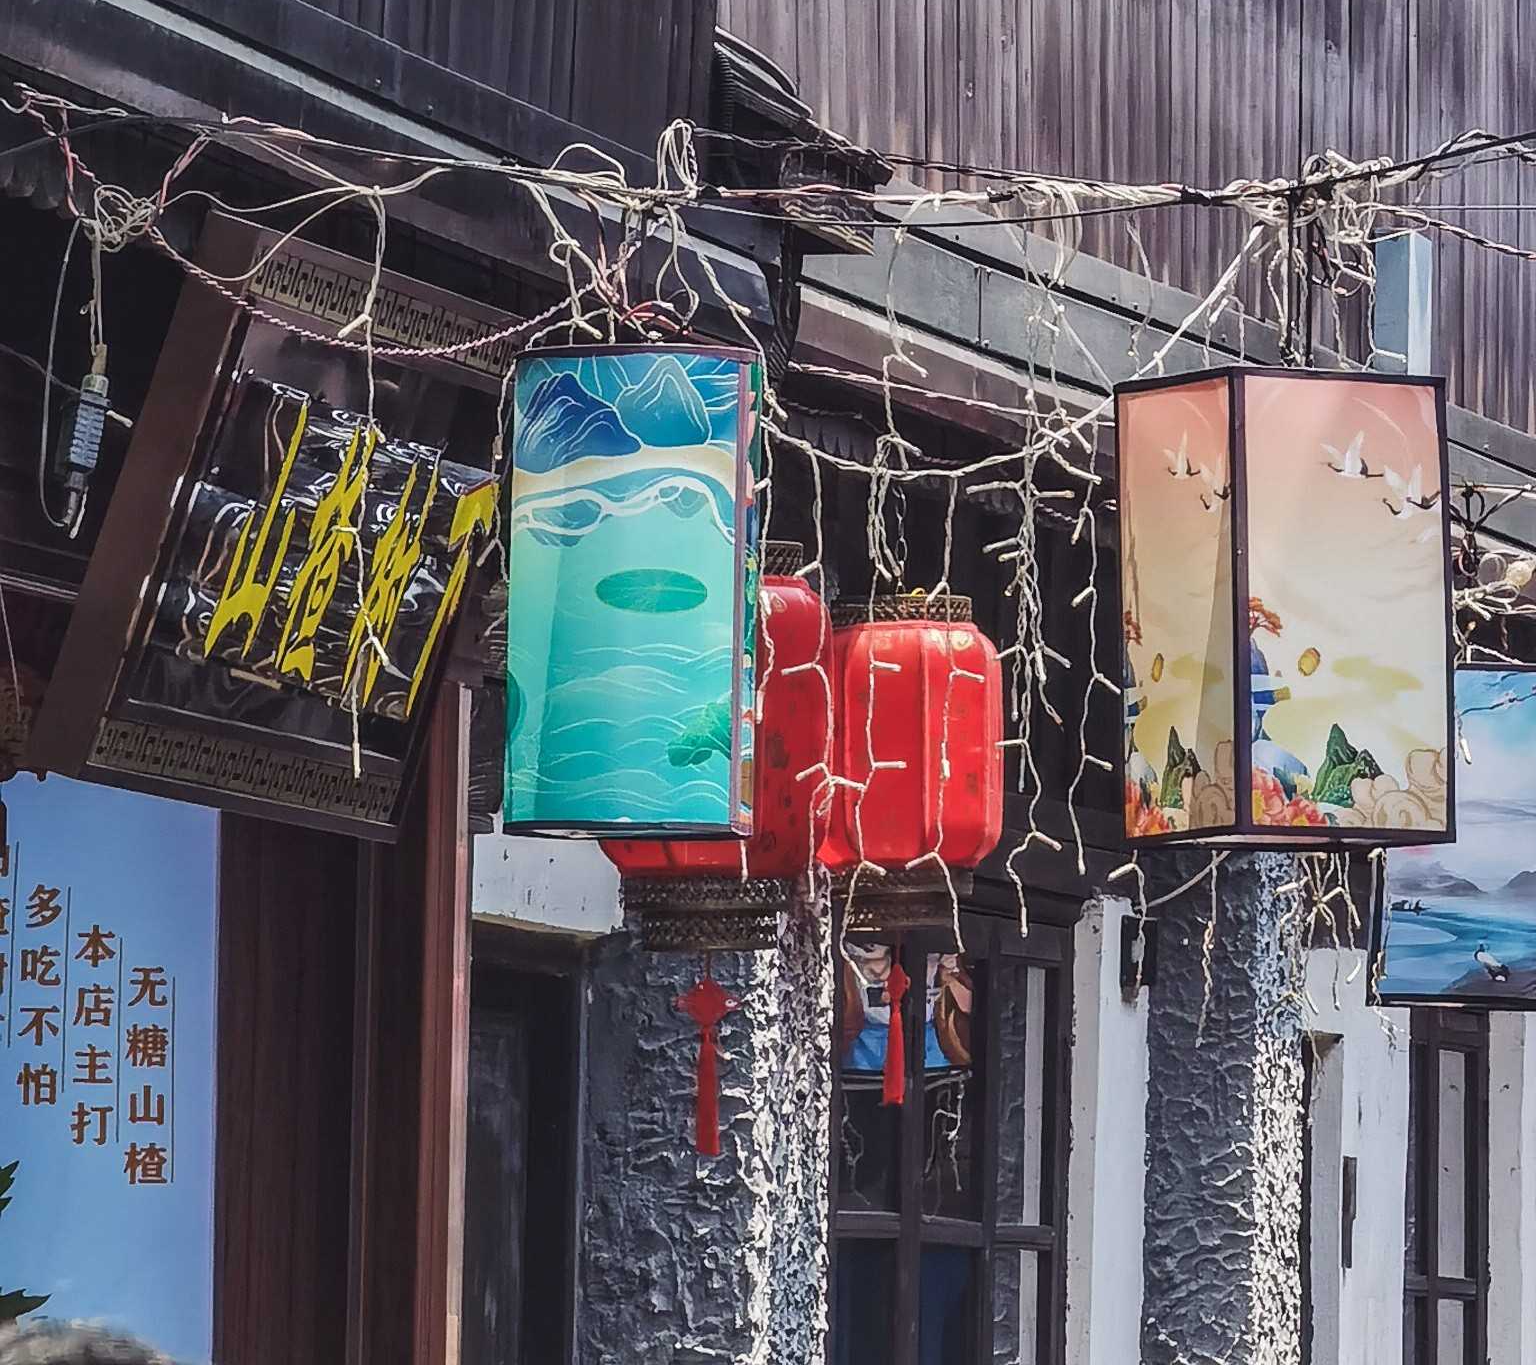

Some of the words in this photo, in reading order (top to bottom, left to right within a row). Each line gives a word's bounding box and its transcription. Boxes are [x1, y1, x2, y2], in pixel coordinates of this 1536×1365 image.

[17, 884, 62, 1106] 多吃不怕
[70, 924, 116, 1147] 本店主打
[124, 965, 168, 1186] 无糖山楂
